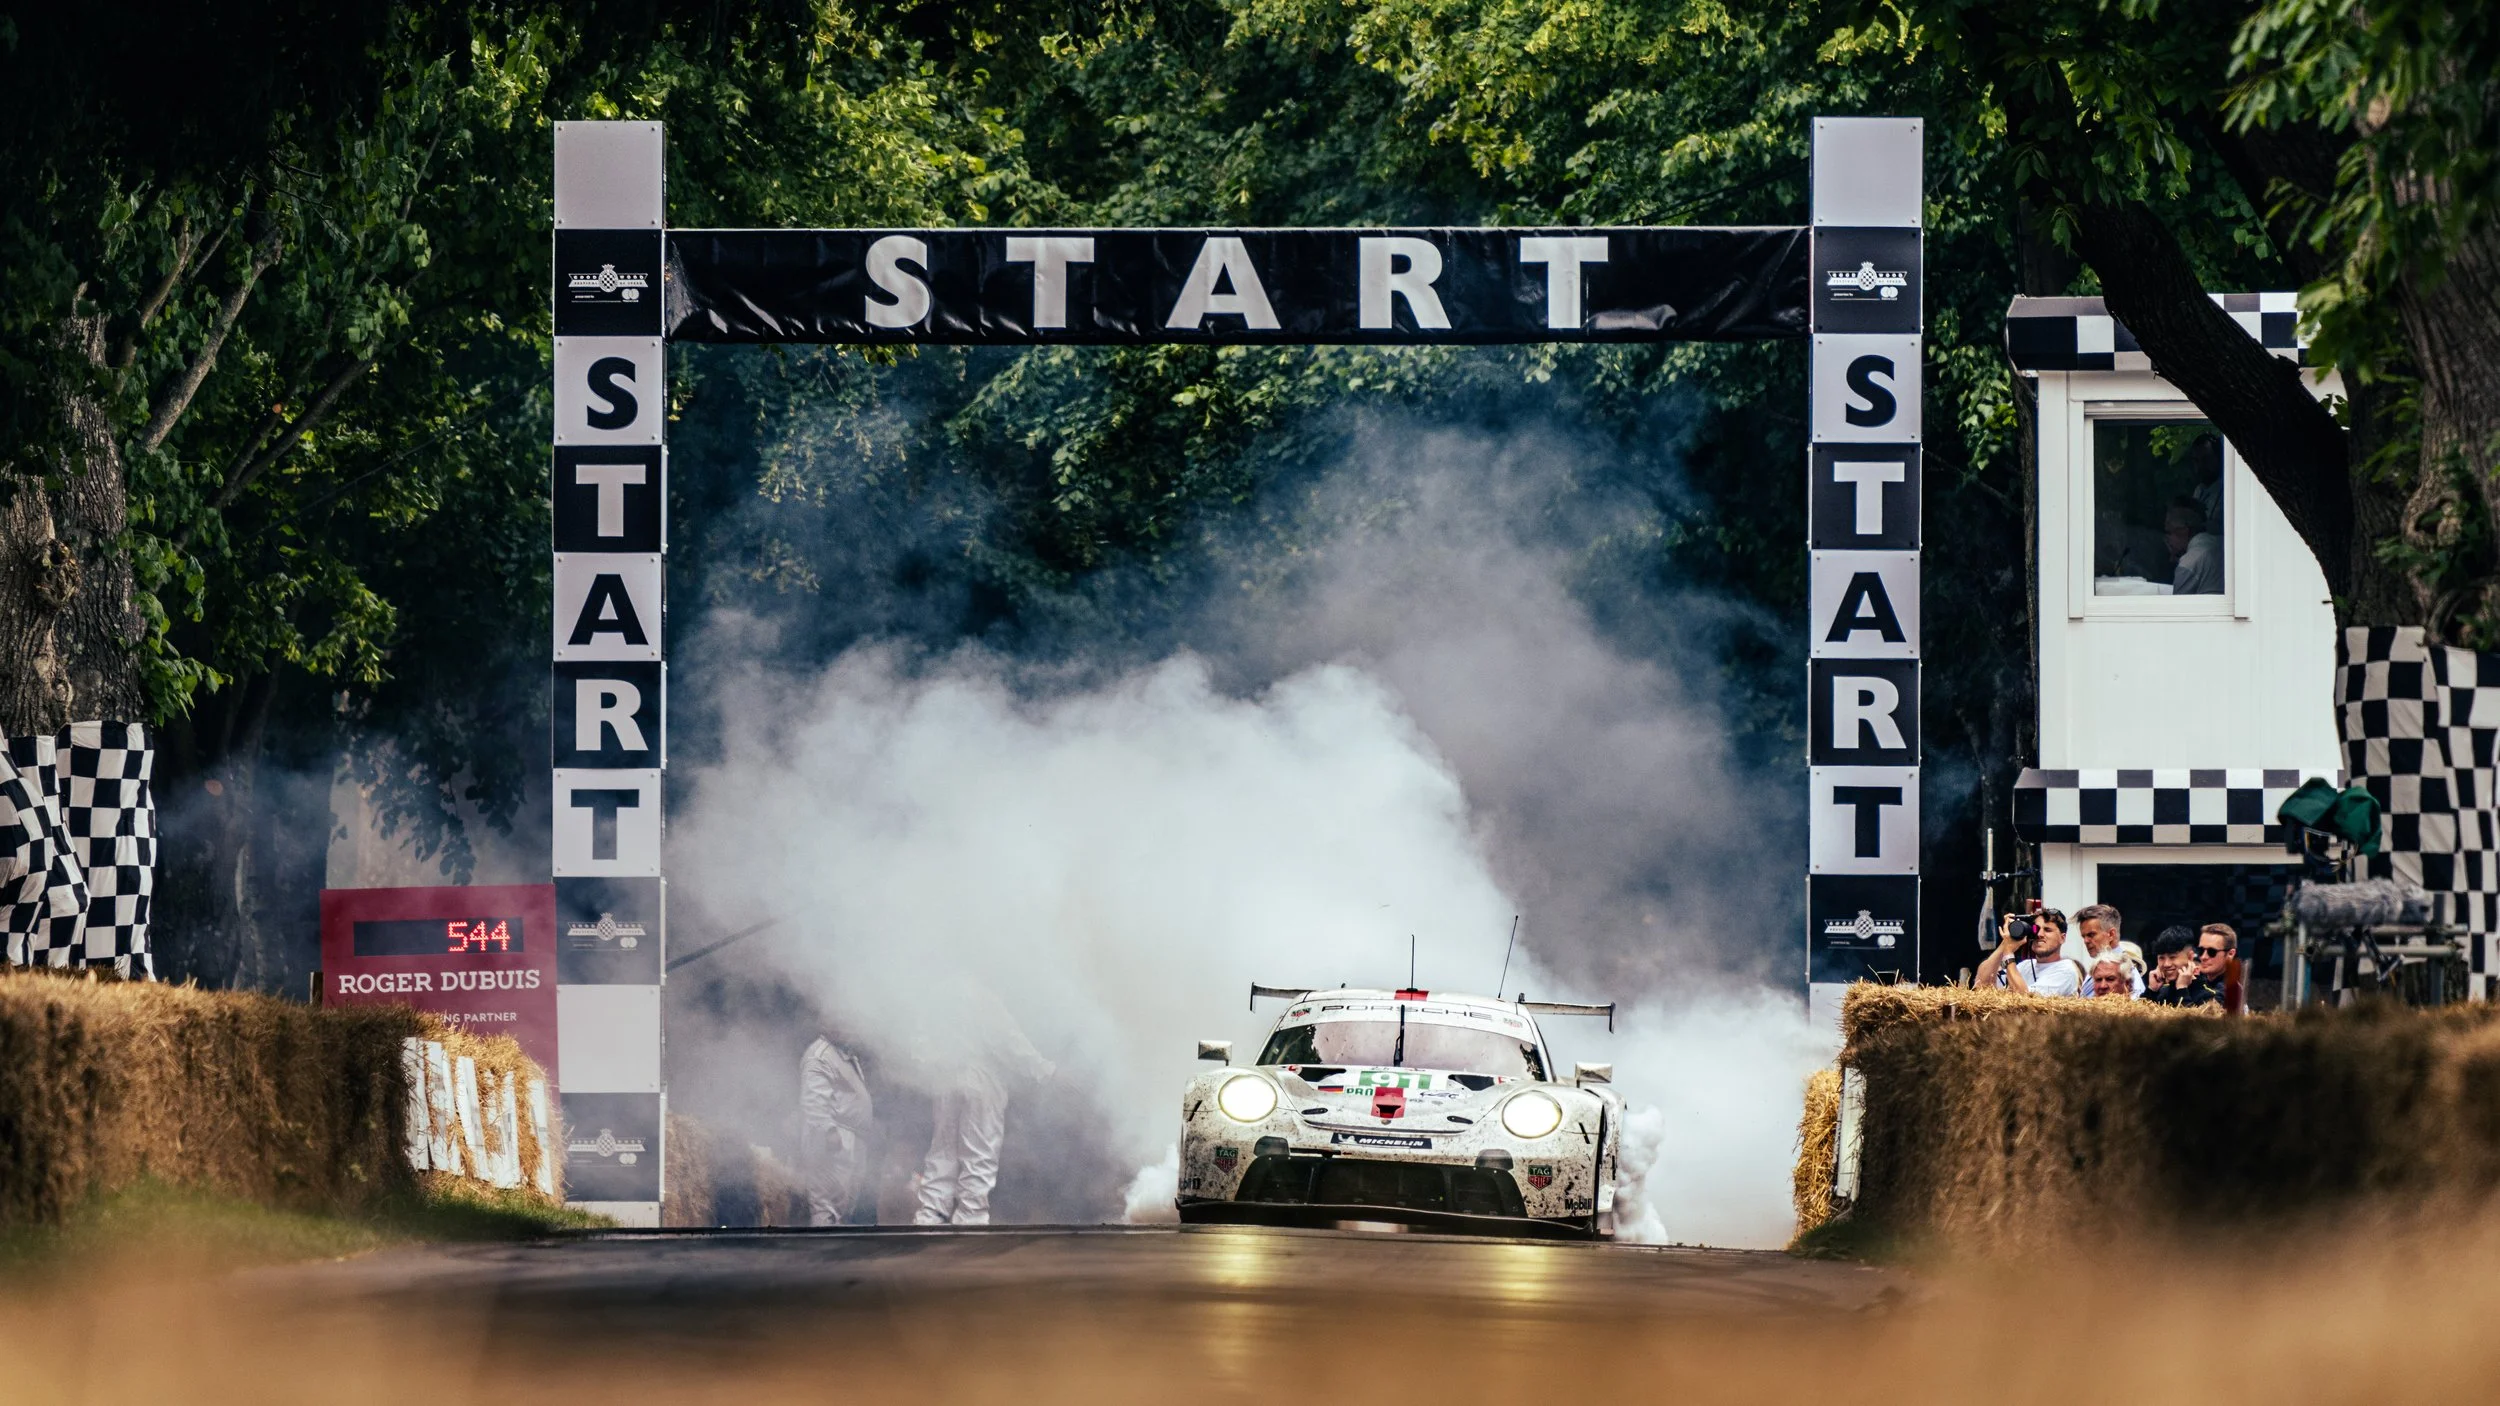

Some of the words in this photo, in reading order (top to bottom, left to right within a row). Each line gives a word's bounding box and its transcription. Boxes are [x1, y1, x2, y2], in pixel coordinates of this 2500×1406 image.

[864, 234, 1609, 330] START
[567, 356, 649, 860] START
[1824, 354, 1907, 859] START
[448, 920, 511, 952] 544
[338, 972, 433, 994] ROGER
[440, 969, 540, 992] DUBUIS
[464, 1012, 517, 1022] PARTNER
[1321, 1005, 1492, 1020] PORSCHE
[1371, 1072, 1421, 1090] 91
[1358, 1138, 1424, 1146] MICHELIN
[1219, 1149, 1235, 1157] TAG
[1531, 1167, 1550, 1175] TAG
